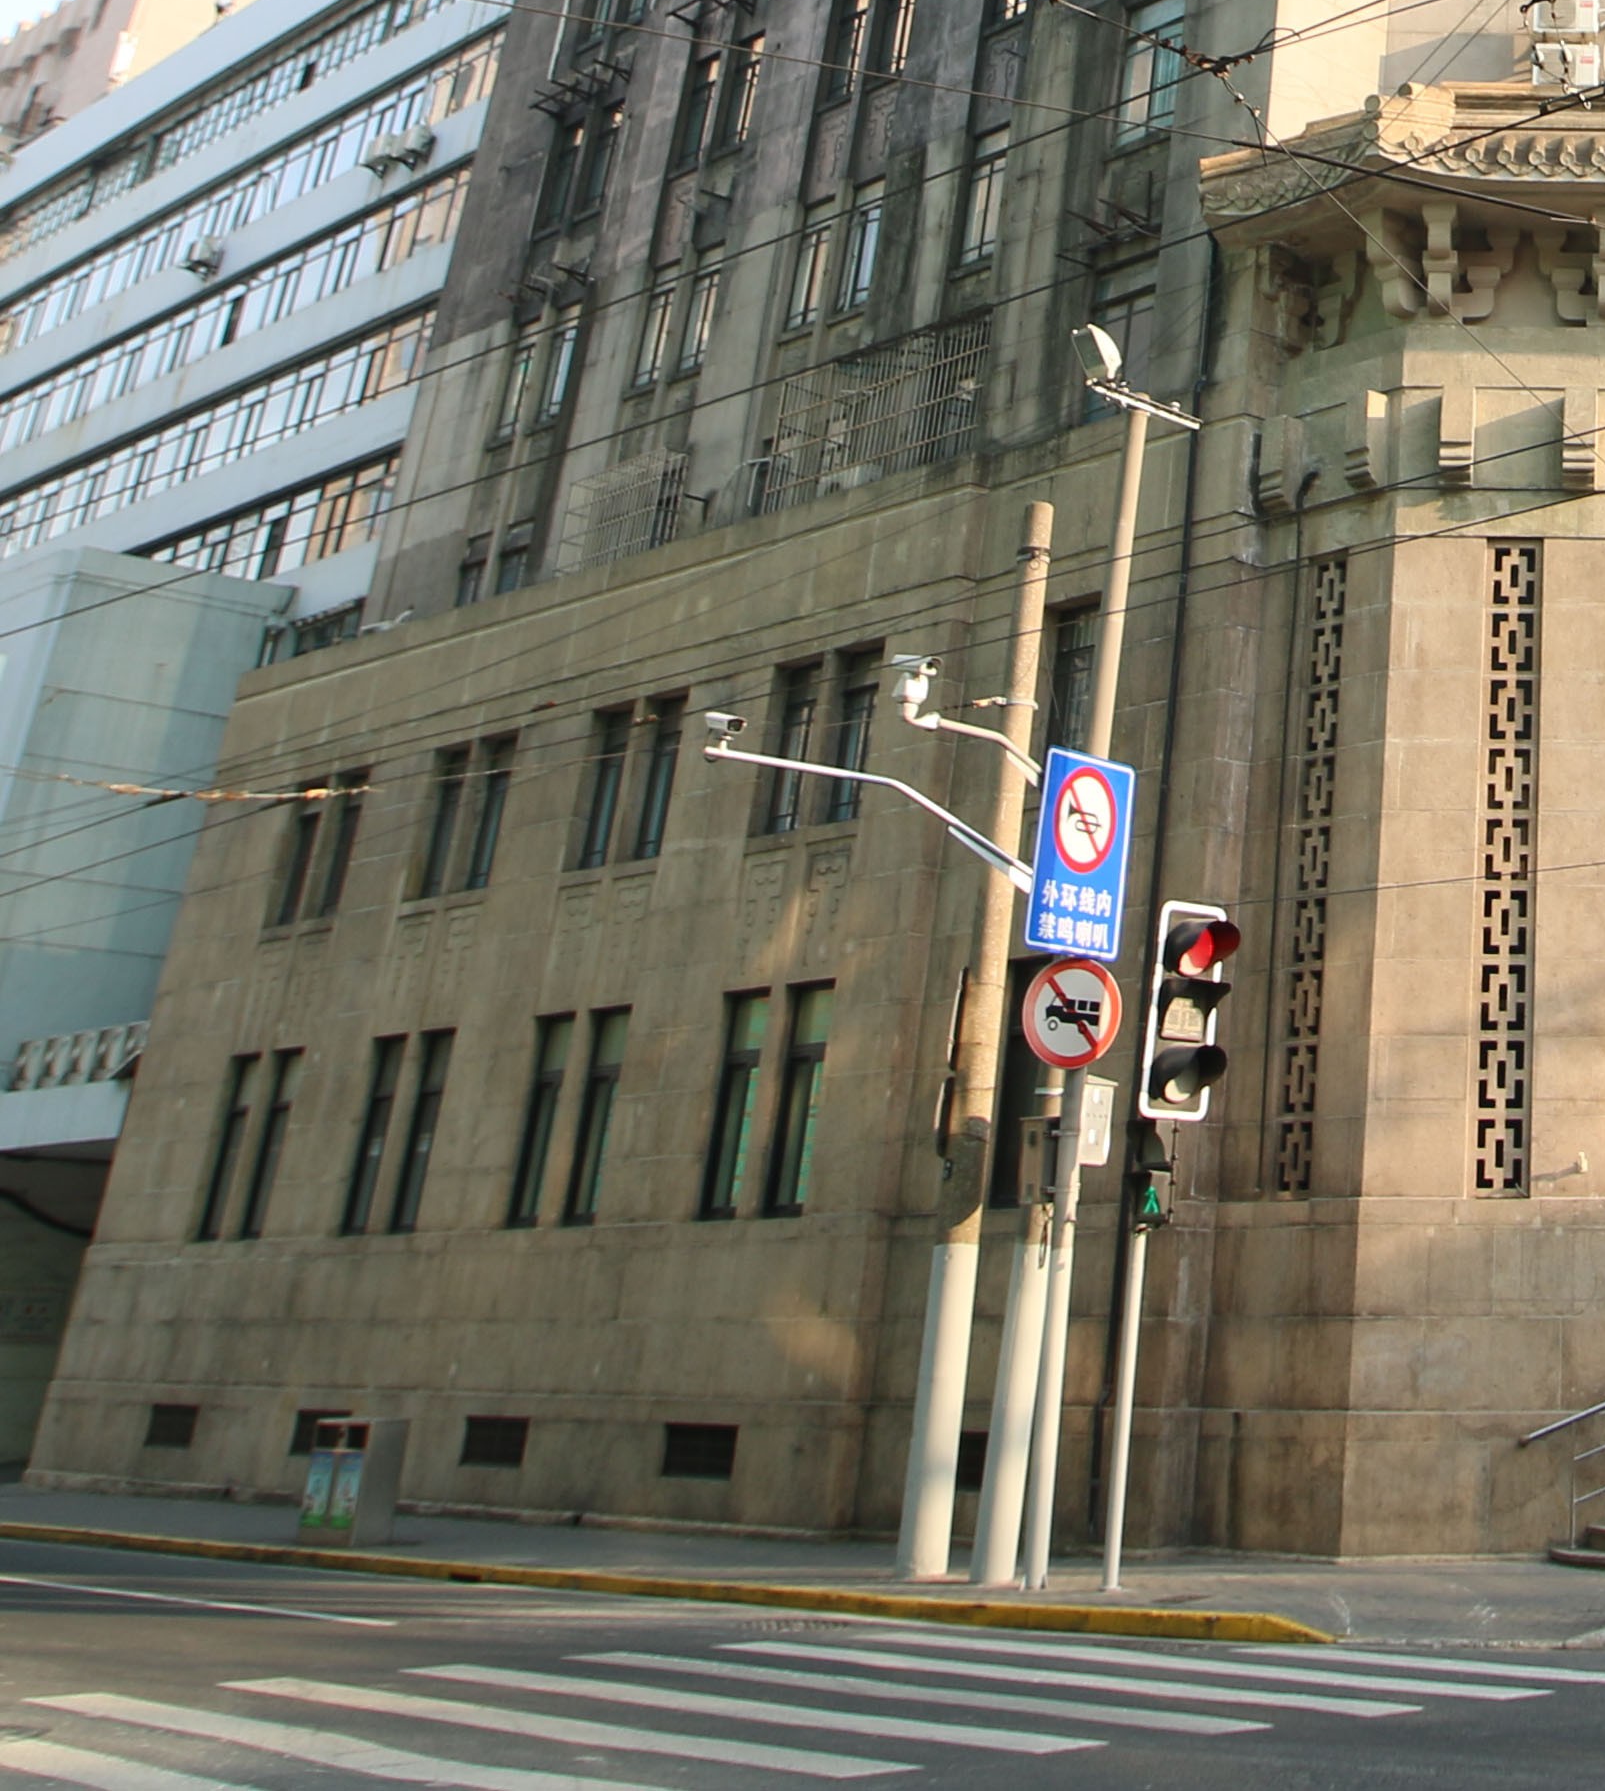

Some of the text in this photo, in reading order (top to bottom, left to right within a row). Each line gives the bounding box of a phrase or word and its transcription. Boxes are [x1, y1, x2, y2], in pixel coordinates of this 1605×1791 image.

[1042, 879, 1112, 917] 外环线内
[1038, 911, 1108, 949] 禁鸣喇叭
